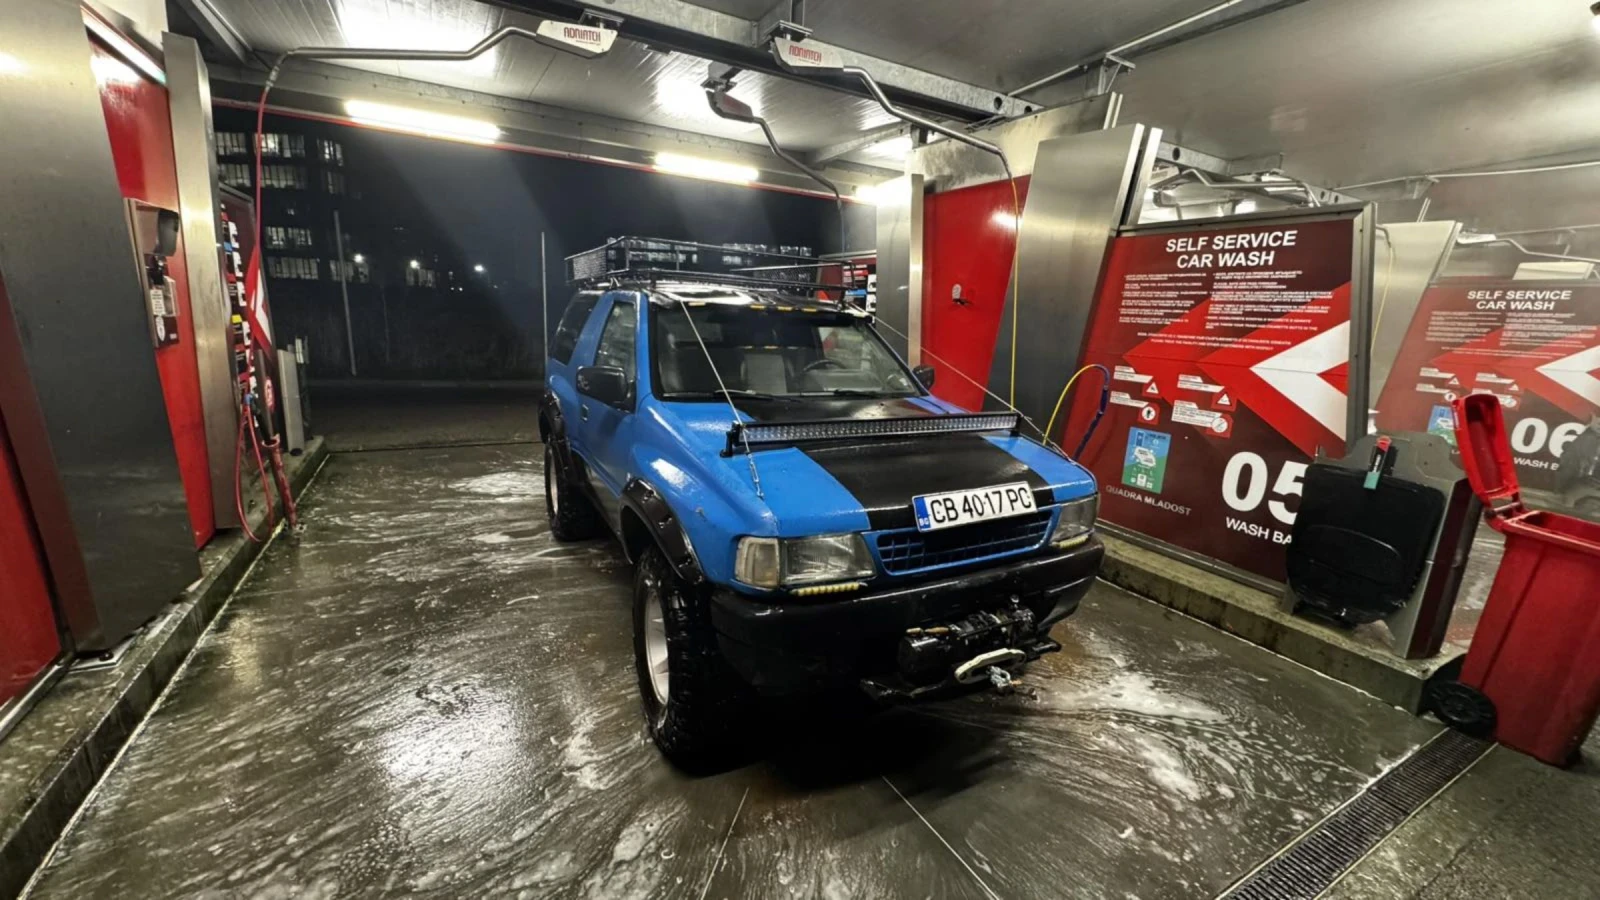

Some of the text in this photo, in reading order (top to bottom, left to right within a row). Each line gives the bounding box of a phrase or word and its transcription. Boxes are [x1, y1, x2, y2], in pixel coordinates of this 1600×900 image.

[1166, 230, 1298, 252] SELF SERVICE
[1176, 251, 1275, 268] CAR WASH
[1467, 290, 1571, 300] SELF SERVICE
[1476, 301, 1555, 310] CAR WASH
[1511, 417, 1587, 458] 06
[1513, 457, 1549, 468] WASH
[1106, 485, 1191, 516] QUADRA MLADOST
[1222, 451, 1308, 525] 05
[930, 487, 1032, 523] CB 4017 PC
[1225, 516, 1292, 546] WASH BA
